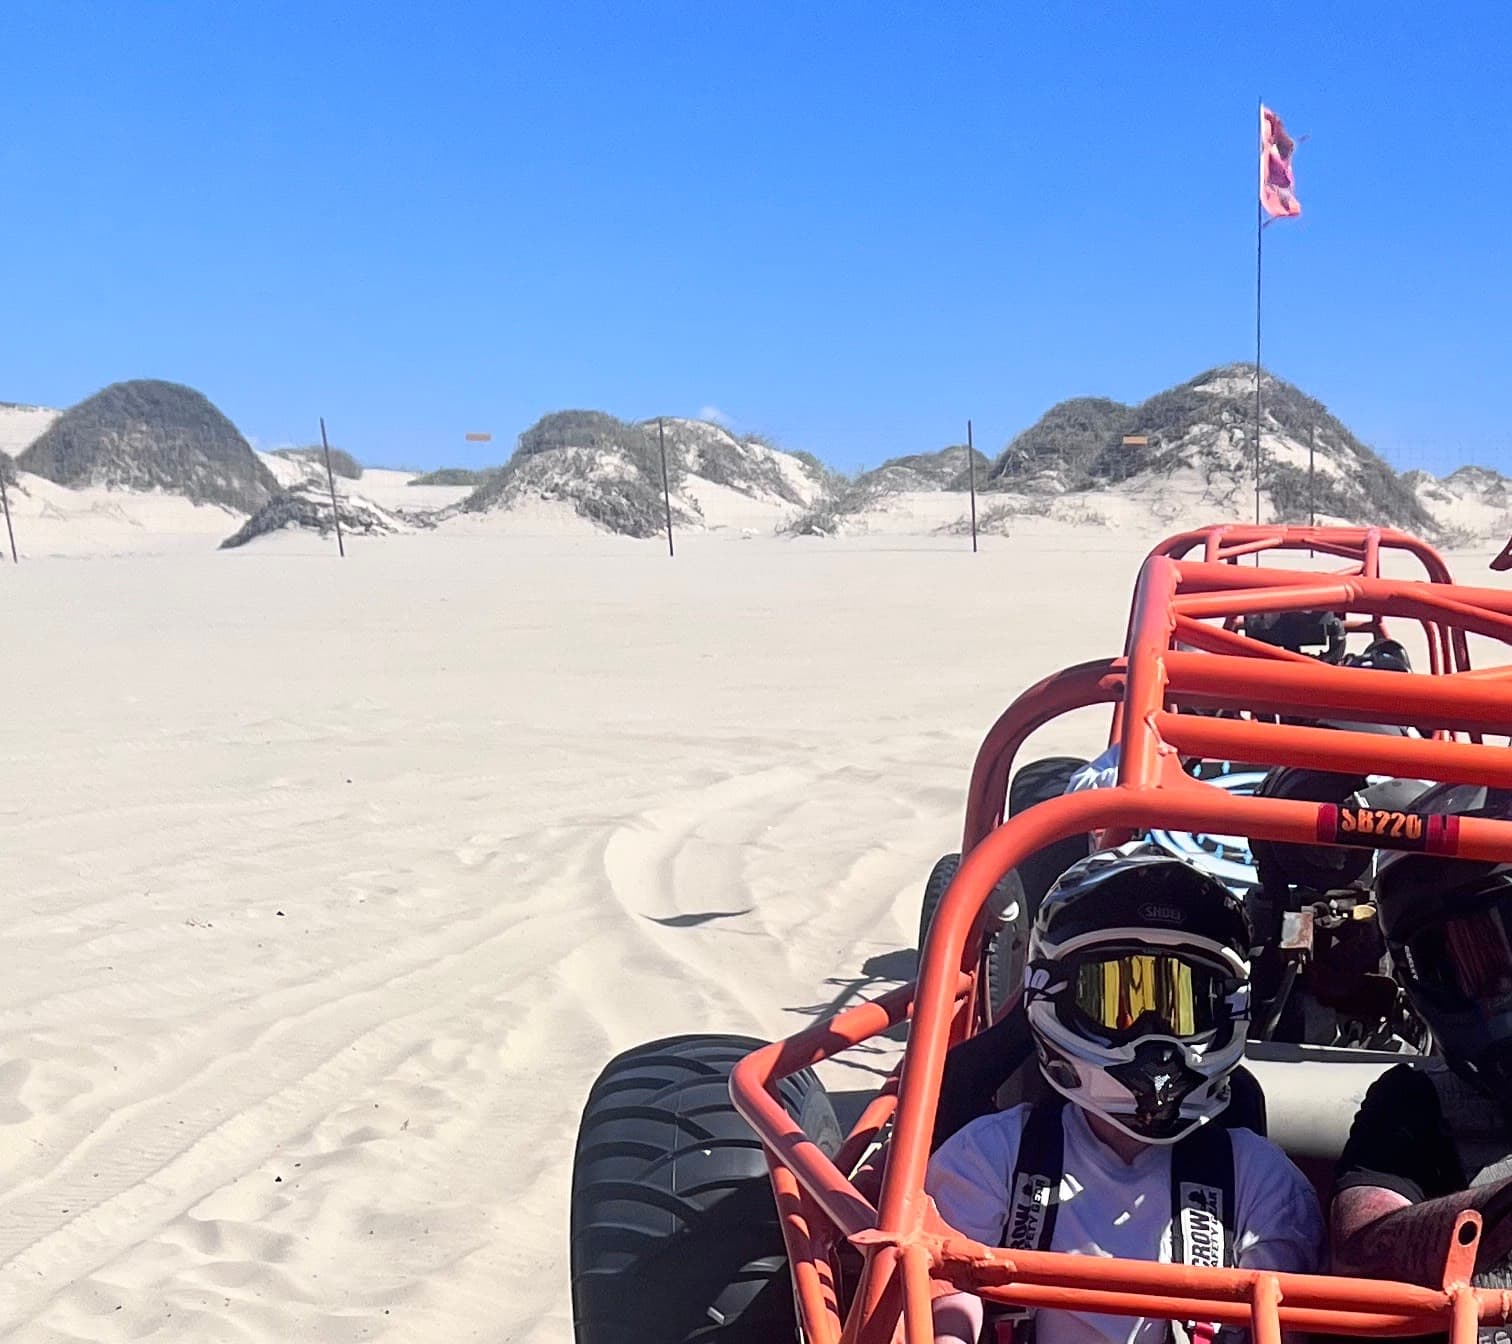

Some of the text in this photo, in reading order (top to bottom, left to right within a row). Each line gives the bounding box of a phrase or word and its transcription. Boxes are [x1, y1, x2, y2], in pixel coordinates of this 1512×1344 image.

[1341, 808, 1422, 839] SB220
[1010, 1203, 1031, 1249] ROW
[1023, 1215, 1039, 1249] FETY
[1210, 1227, 1220, 1268] AFETY
